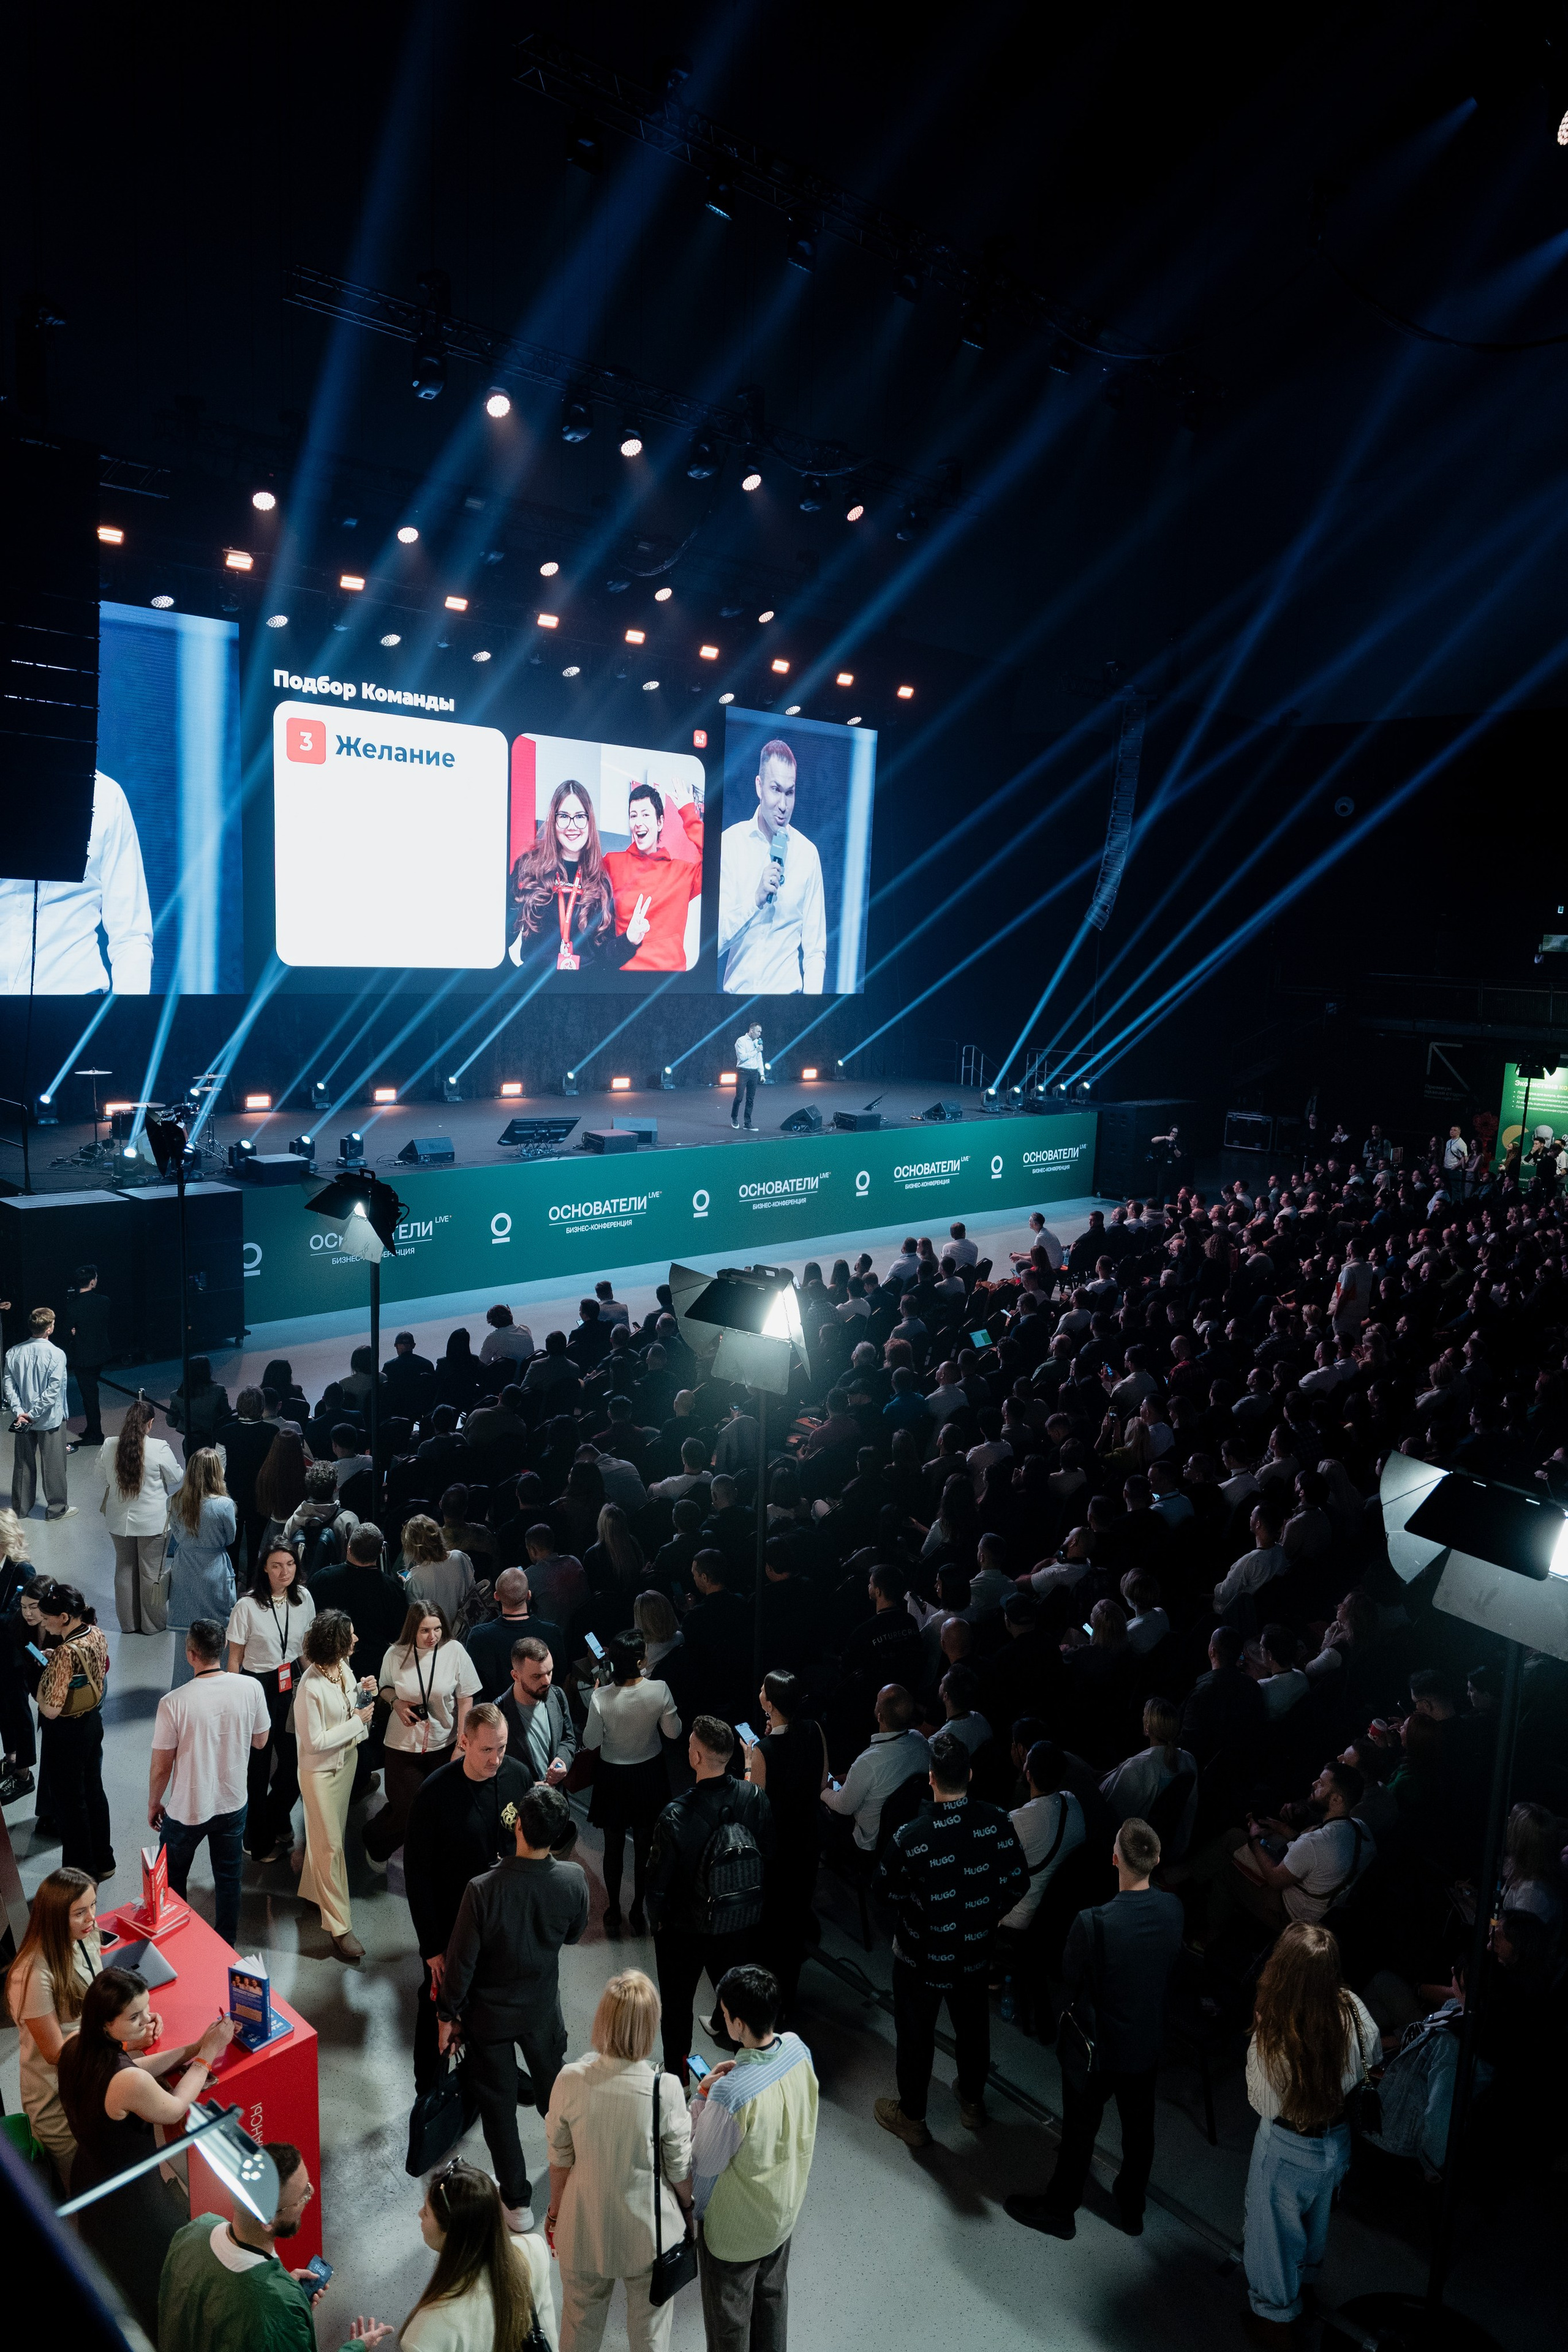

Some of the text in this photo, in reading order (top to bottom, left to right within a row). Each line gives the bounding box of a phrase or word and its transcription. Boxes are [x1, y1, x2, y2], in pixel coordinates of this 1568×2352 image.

[274, 669, 454, 712] Подбор Команды
[299, 731, 313, 751] 3
[336, 734, 455, 767] Желание
[1023, 1147, 1079, 1164] ОСНОВАТЕЛИ
[894, 1159, 960, 1178] ОСНОВАТЕЛИ
[1032, 1165, 1070, 1174] БИЗНЕС-КОНФЕРЕНЦИЯ
[739, 1176, 818, 1198] ОСНОВАТЕЛИ
[905, 1179, 950, 1189] БИЗНЕС-КОНФЕРЕНЦИЯ
[549, 1196, 647, 1221] ОСНОВАТЕЛИ
[752, 1198, 807, 1210] БИЗНЕС-КОНФЕРЕНЦИЯ
[566, 1219, 632, 1234] БИЗНЕС-КОНФЕРЕНЦИЯ
[943, 1796, 968, 1811] HUGO
[933, 1814, 961, 1829] HUGO
[973, 1825, 998, 1838] HUGO
[930, 1854, 956, 1868] HUGO
[963, 1863, 990, 1875] HUGO
[930, 1889, 956, 1902] HUGO
[965, 1896, 990, 1909] HUGO
[930, 1921, 956, 1933] HUGO
[963, 1929, 989, 1942] HUGO
[927, 1953, 955, 1962] HUGO
[251, 2101, 263, 2146] АНСЫ
